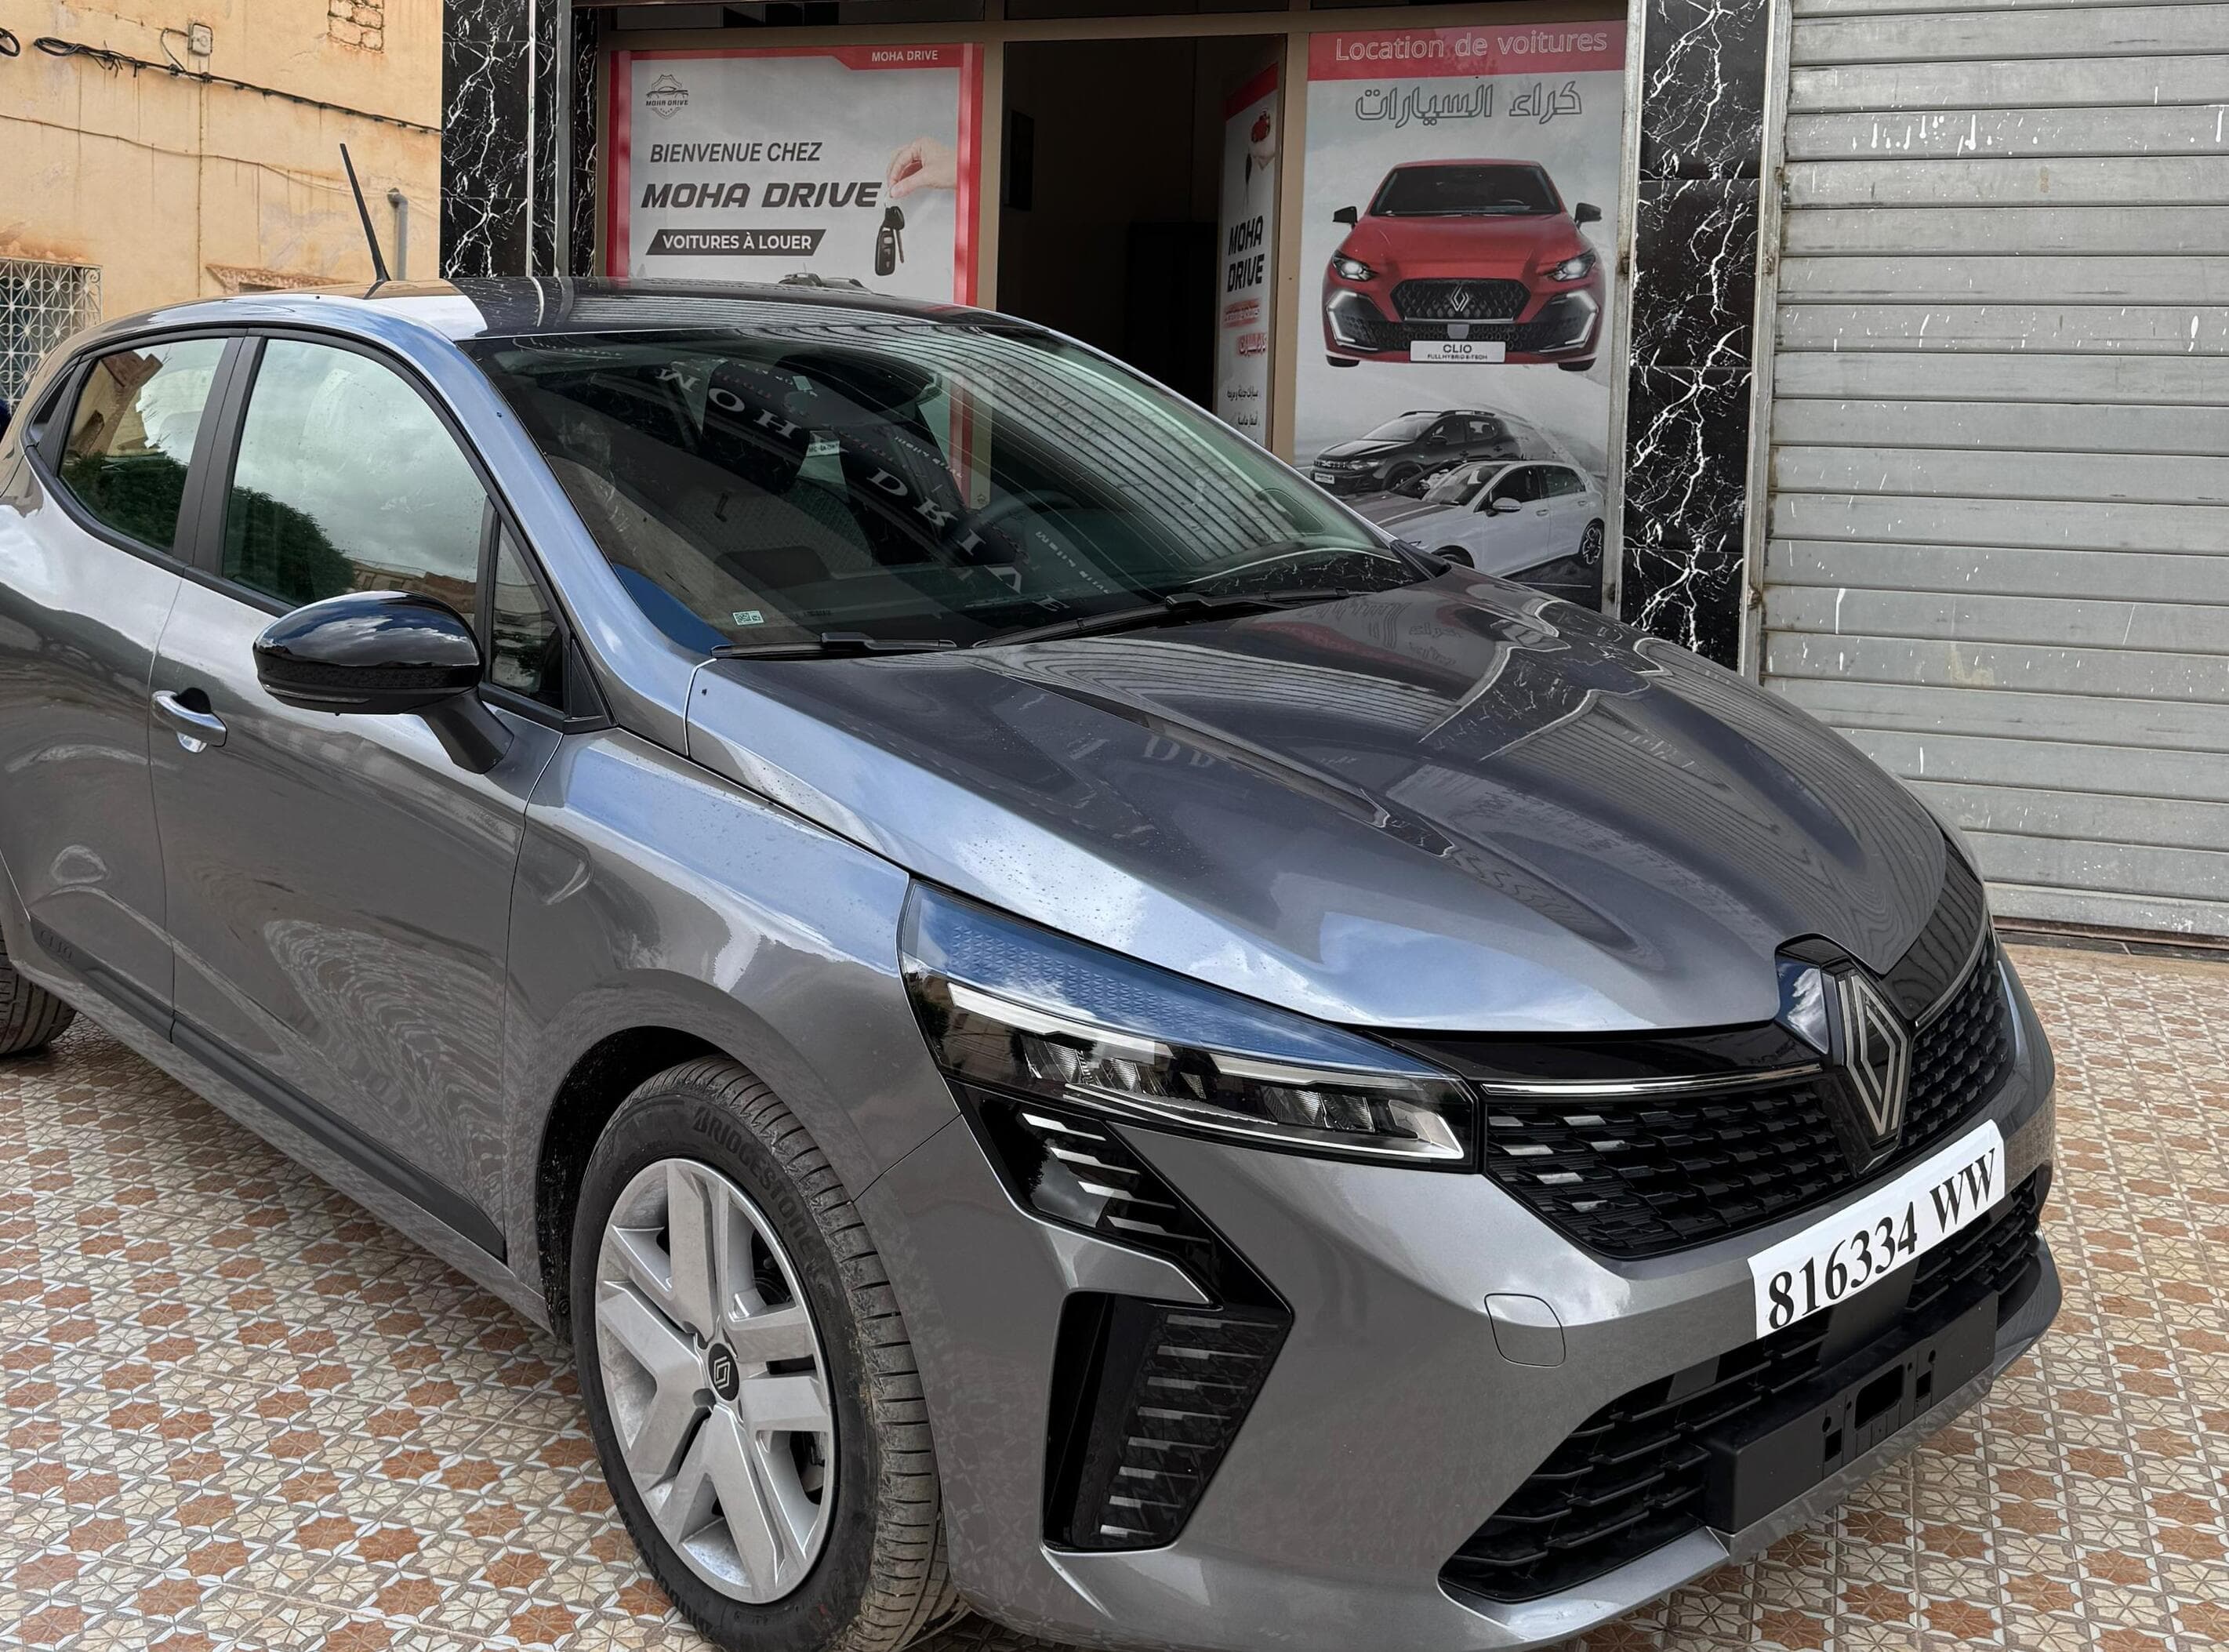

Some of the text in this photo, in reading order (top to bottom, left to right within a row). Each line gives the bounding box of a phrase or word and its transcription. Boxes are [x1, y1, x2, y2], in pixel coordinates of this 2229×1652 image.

[872, 50, 938, 62] MOHA DRIVE
[1335, 31, 1607, 61] Location de voitures
[1356, 81, 1582, 129] كراء السيارات
[650, 142, 822, 162] BIENVENUE CHEZ
[641, 182, 882, 208] MOHA DRIVE
[663, 230, 812, 250] VOITURES À LOUER
[1228, 215, 1264, 256] MOHA
[1227, 253, 1265, 292] DRIVE
[1443, 344, 1472, 354] CLIO
[1769, 1147, 1995, 1330] 816334 WW
